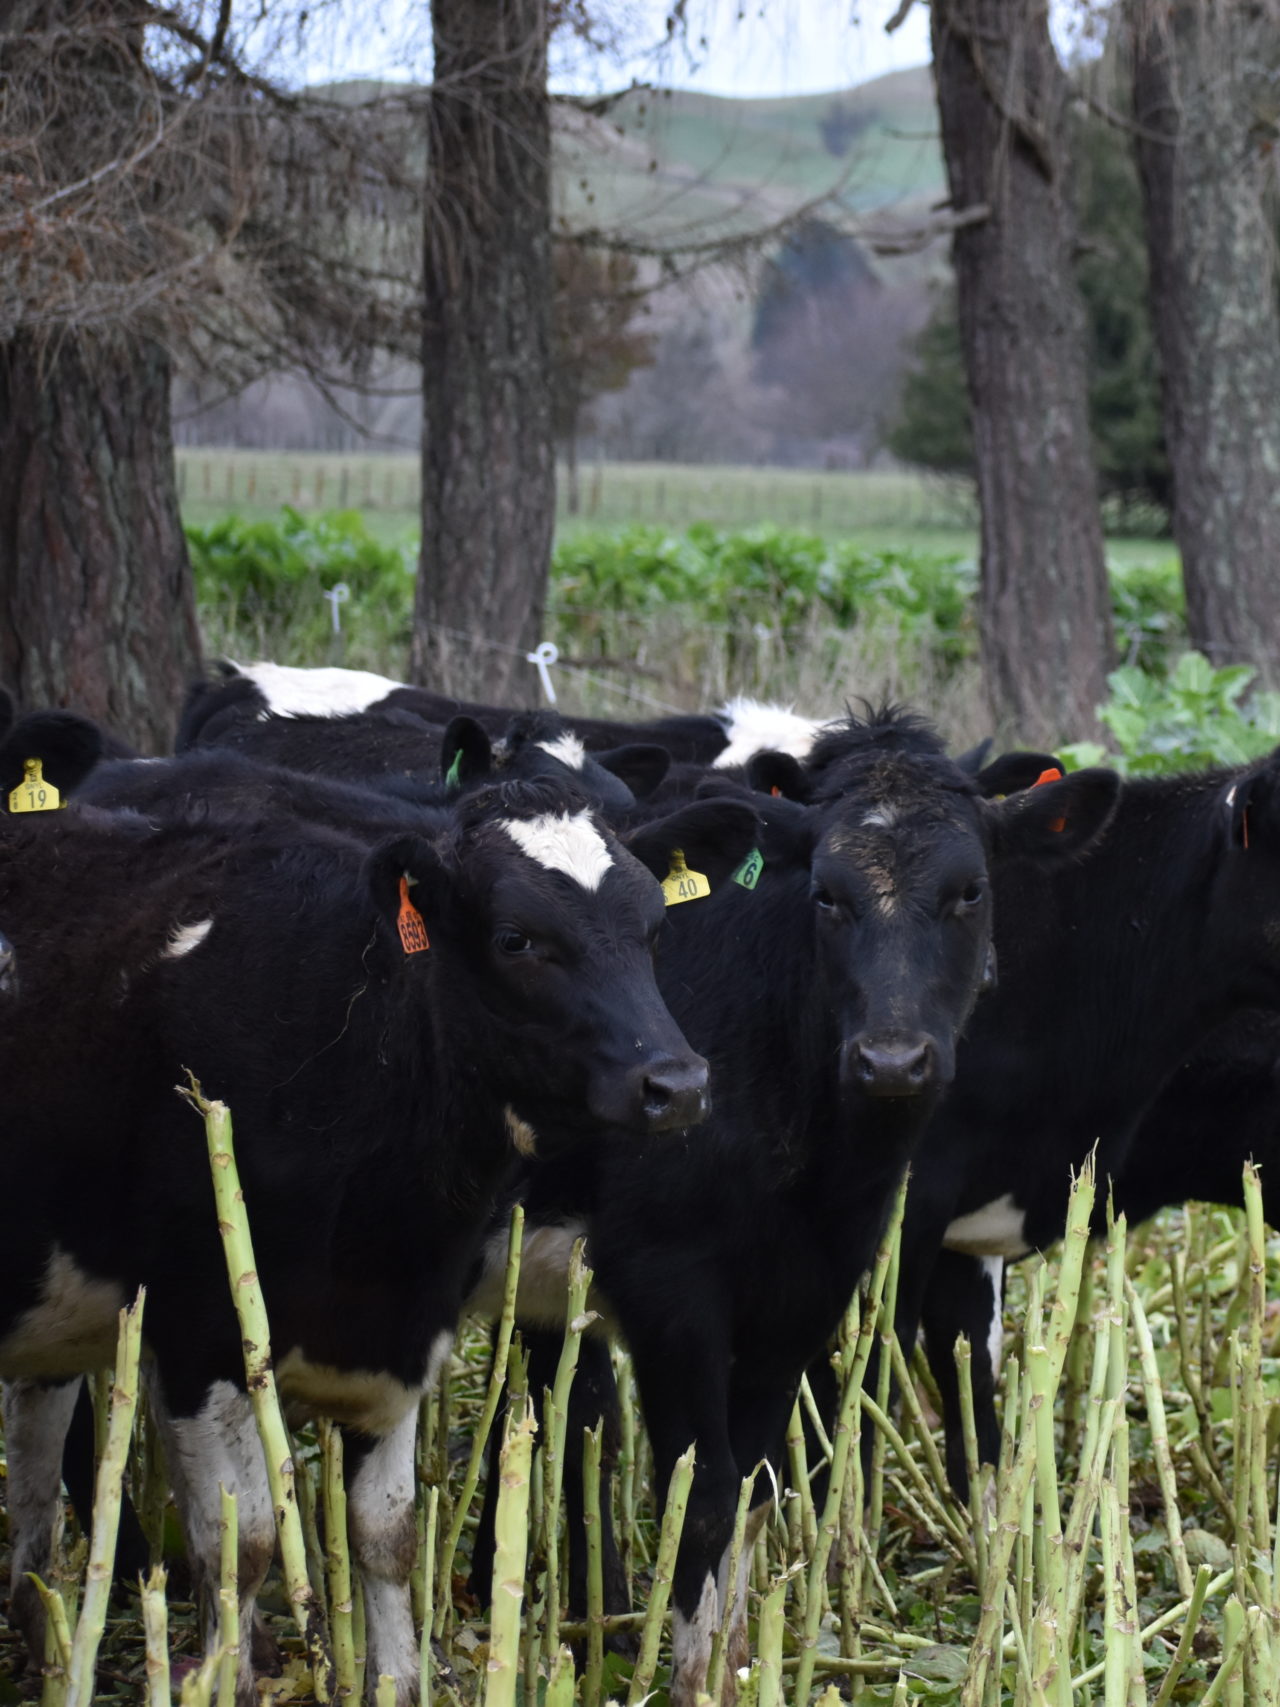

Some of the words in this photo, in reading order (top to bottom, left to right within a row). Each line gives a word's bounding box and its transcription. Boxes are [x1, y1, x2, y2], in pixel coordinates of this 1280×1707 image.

[28, 789, 47, 809] 19
[743, 862, 757, 886] 6
[678, 878, 698, 898] 40
[400, 921, 427, 952] 8593
